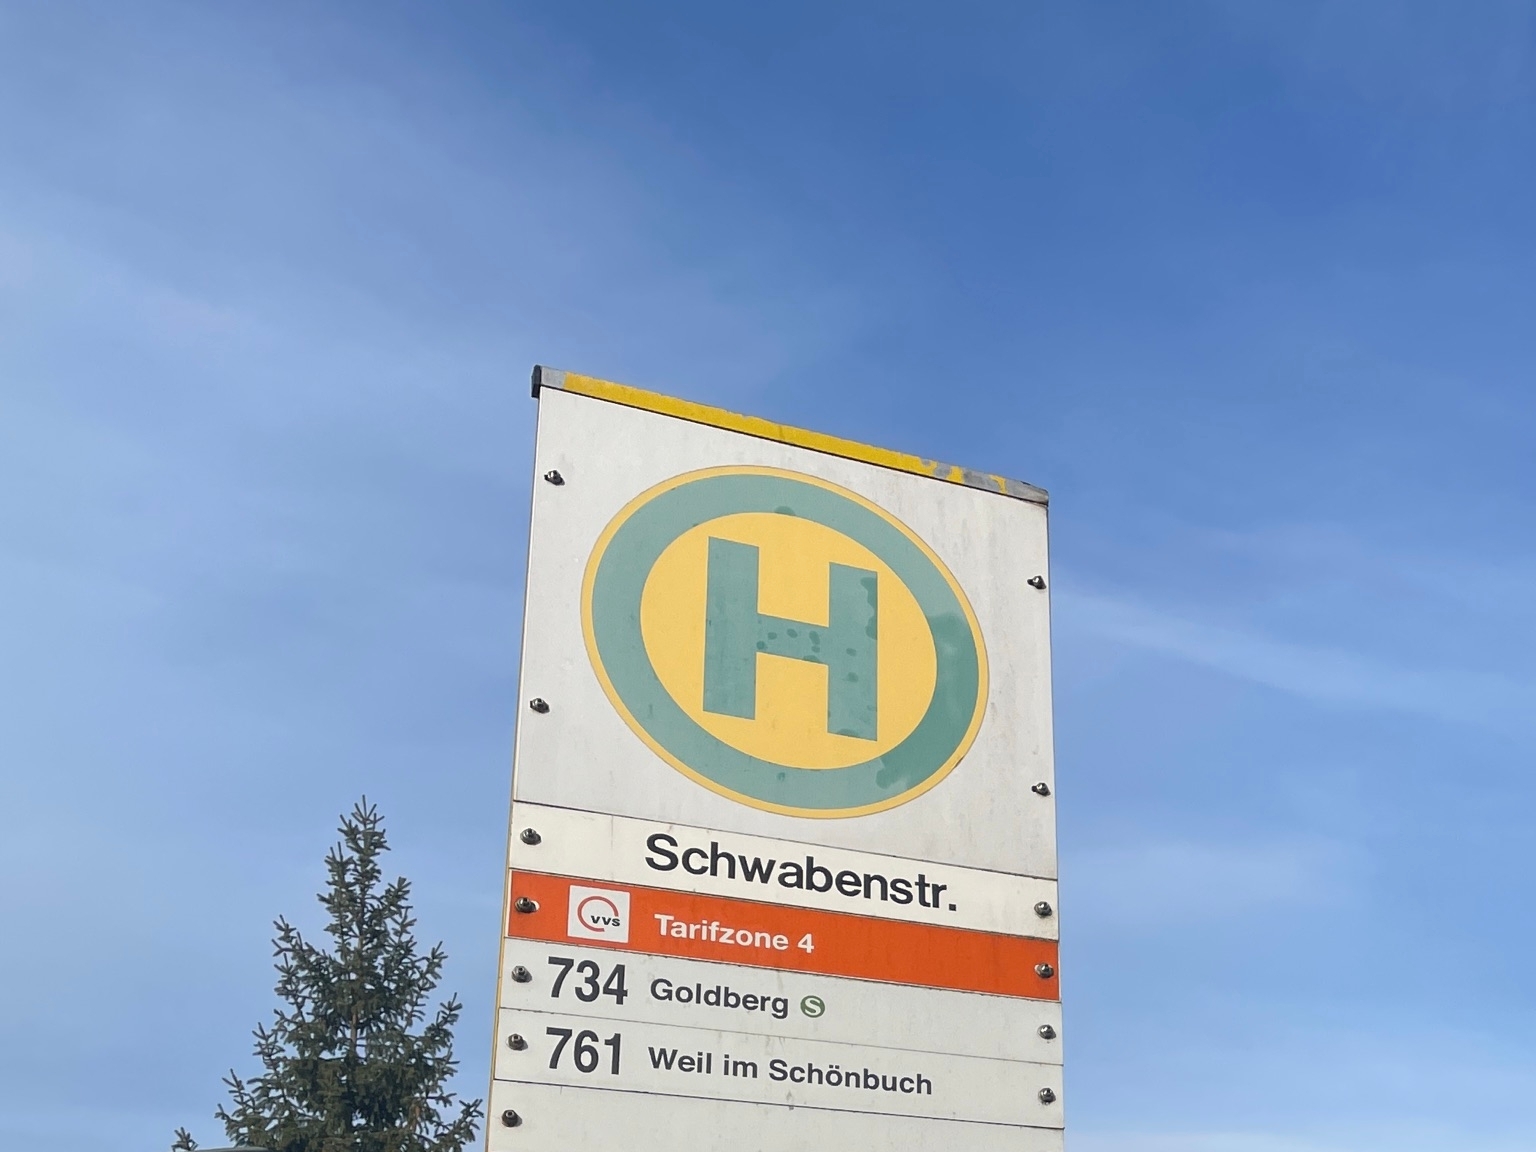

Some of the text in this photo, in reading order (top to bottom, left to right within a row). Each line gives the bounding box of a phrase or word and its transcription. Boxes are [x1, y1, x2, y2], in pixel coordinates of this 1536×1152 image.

[703, 536, 877, 741] H
[645, 833, 957, 912] Schwabenstr.
[654, 913, 815, 954] Tarifzone 4
[547, 956, 628, 1006] 734
[650, 978, 789, 1020] Goldberg
[545, 1026, 932, 1095] 761 Weil im Schönbuch
